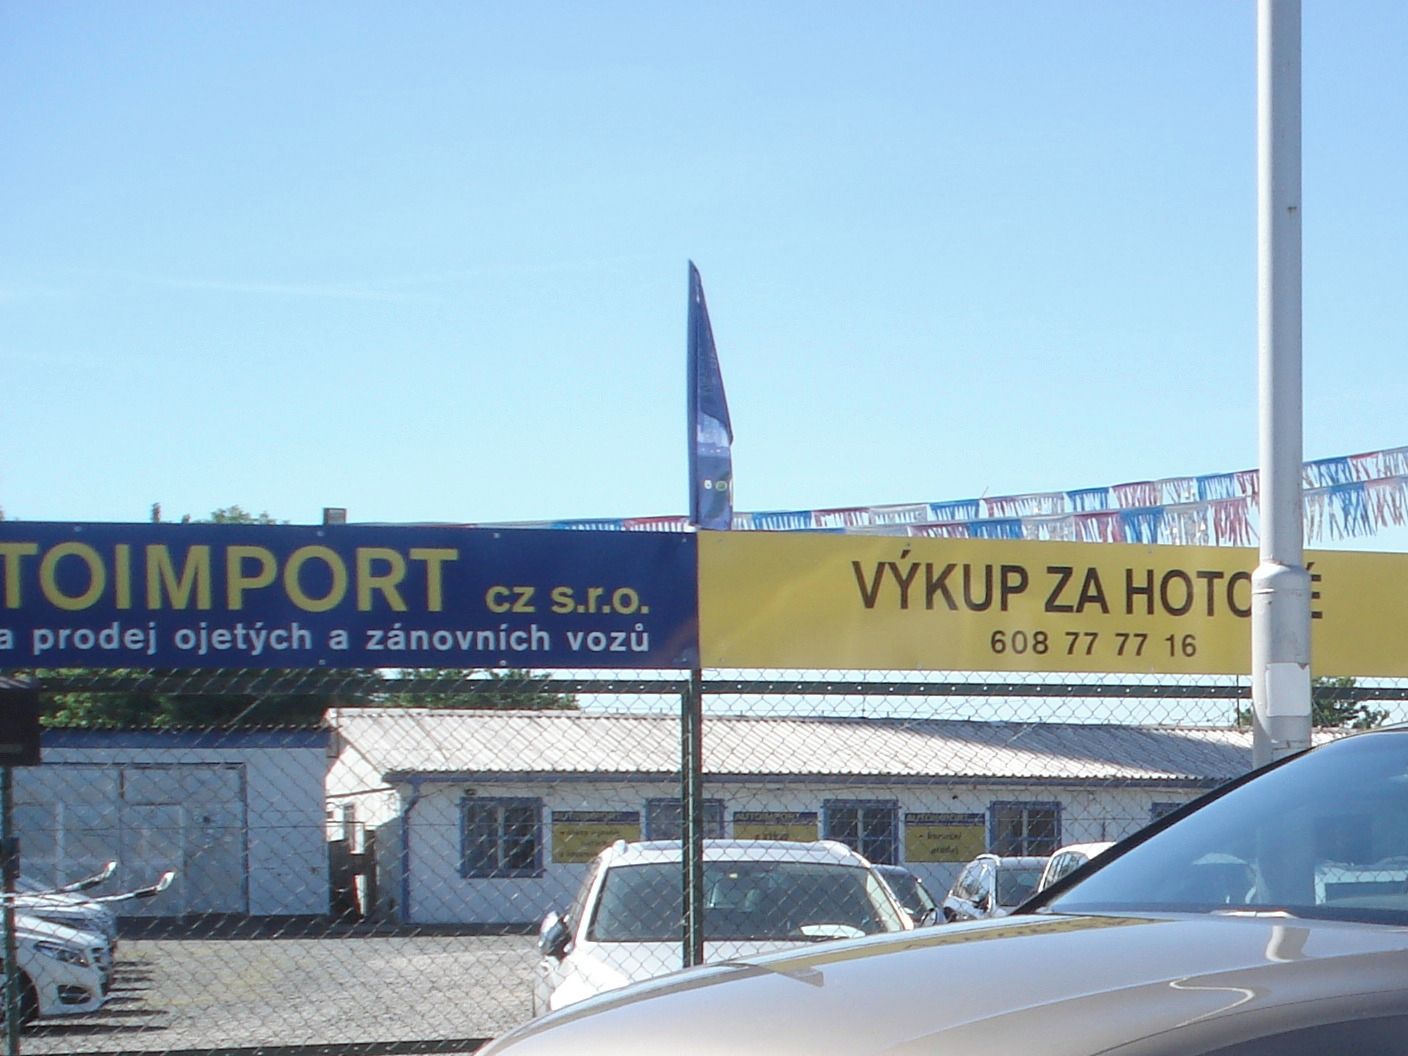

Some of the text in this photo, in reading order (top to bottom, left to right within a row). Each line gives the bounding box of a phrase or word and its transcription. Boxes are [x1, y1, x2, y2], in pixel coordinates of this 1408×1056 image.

[486, 586, 535, 614] cz
[551, 585, 650, 615] s.r.o.
[852, 549, 1323, 620] VÝKUP ZA HOTO
[33, 621, 157, 656] prodej
[175, 621, 312, 657] ojetých
[329, 629, 349, 651] a
[366, 622, 551, 653] zánovních
[567, 622, 650, 654] vozů
[991, 630, 1198, 658] 608 77 77 16
